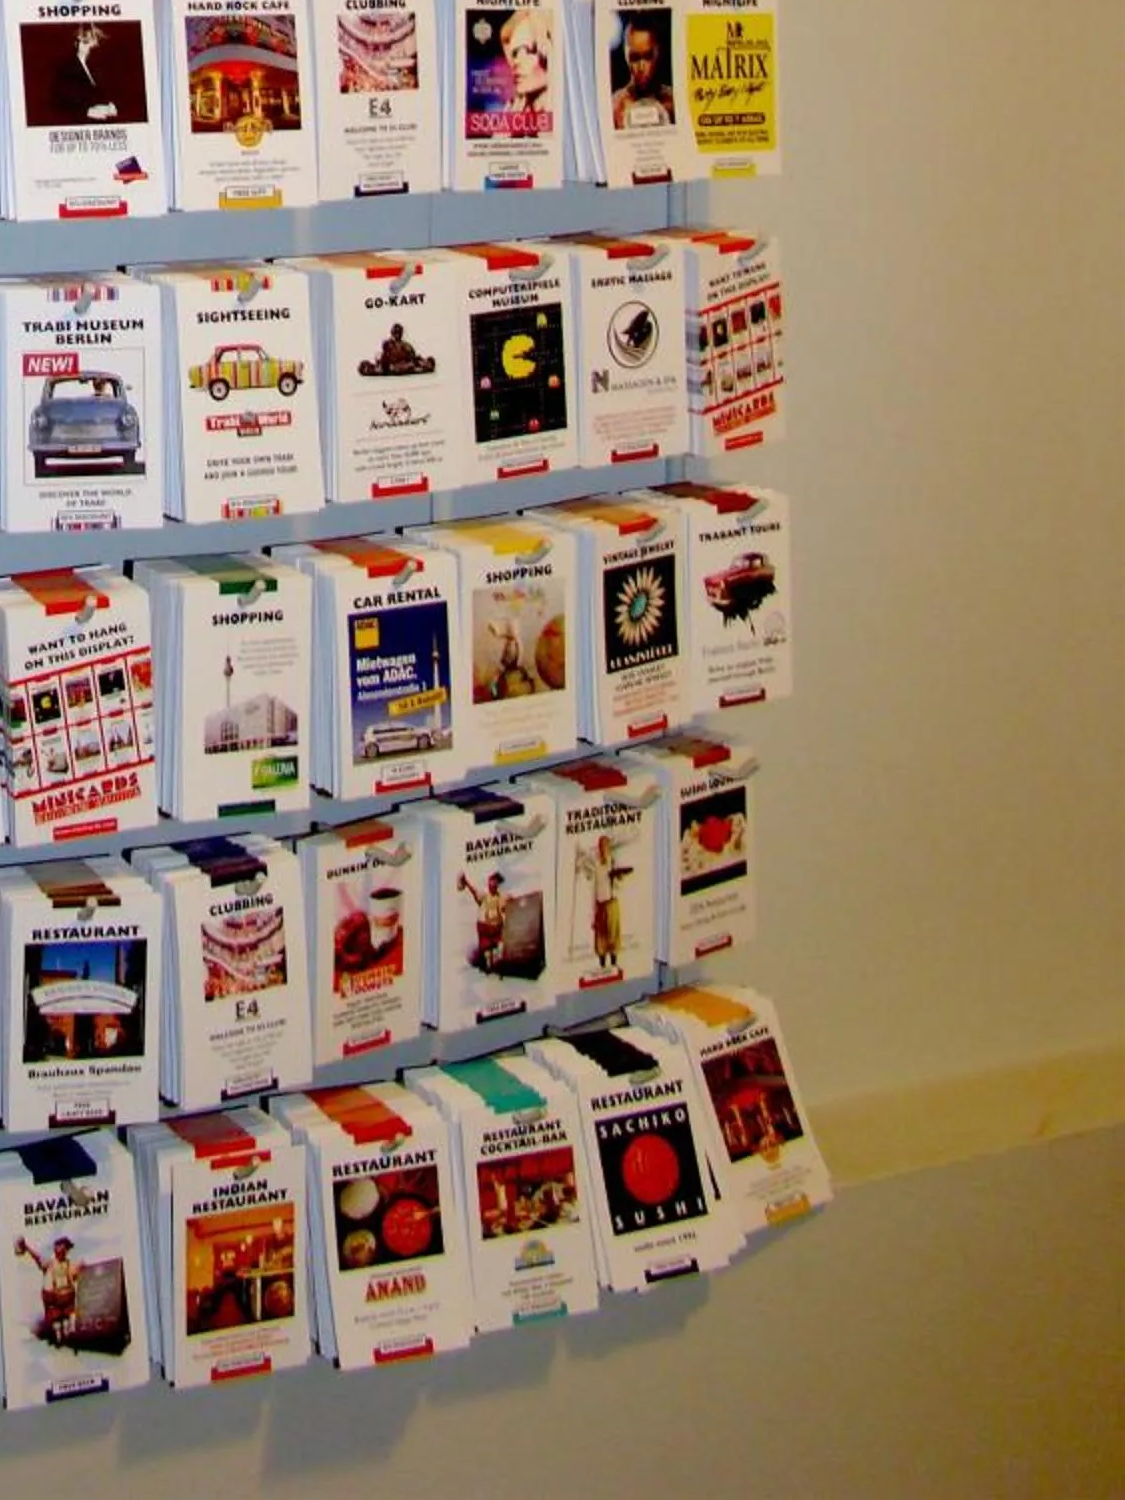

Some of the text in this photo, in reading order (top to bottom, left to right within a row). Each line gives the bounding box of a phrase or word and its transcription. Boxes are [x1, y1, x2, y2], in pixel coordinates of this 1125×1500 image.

[38, 4, 122, 17] SHOPPING
[187, 1, 222, 11] HARD
[226, 0, 258, 11] ROCK
[364, 293, 426, 309] GO-KART
[196, 308, 291, 324] SIGHTSEEING
[23, 318, 144, 333] TRABI MUSEUM
[55, 333, 112, 344] BERLIN
[27, 357, 74, 373] NEW!
[485, 564, 553, 584] SHOPPING
[353, 587, 441, 610] CAR RENTAL
[212, 610, 284, 626] SHOPPING
[28, 623, 127, 655] WANT TO HANG
[24, 651, 76, 671] ON THIS
[209, 894, 274, 917] CLUBBING
[31, 925, 140, 941] RESTAURANT
[590, 1079, 684, 1111] RESTAURANT
[331, 1149, 438, 1178] RESTAURANT
[212, 1179, 268, 1198] INDIAN
[192, 1188, 288, 1214] RESTAURANT
